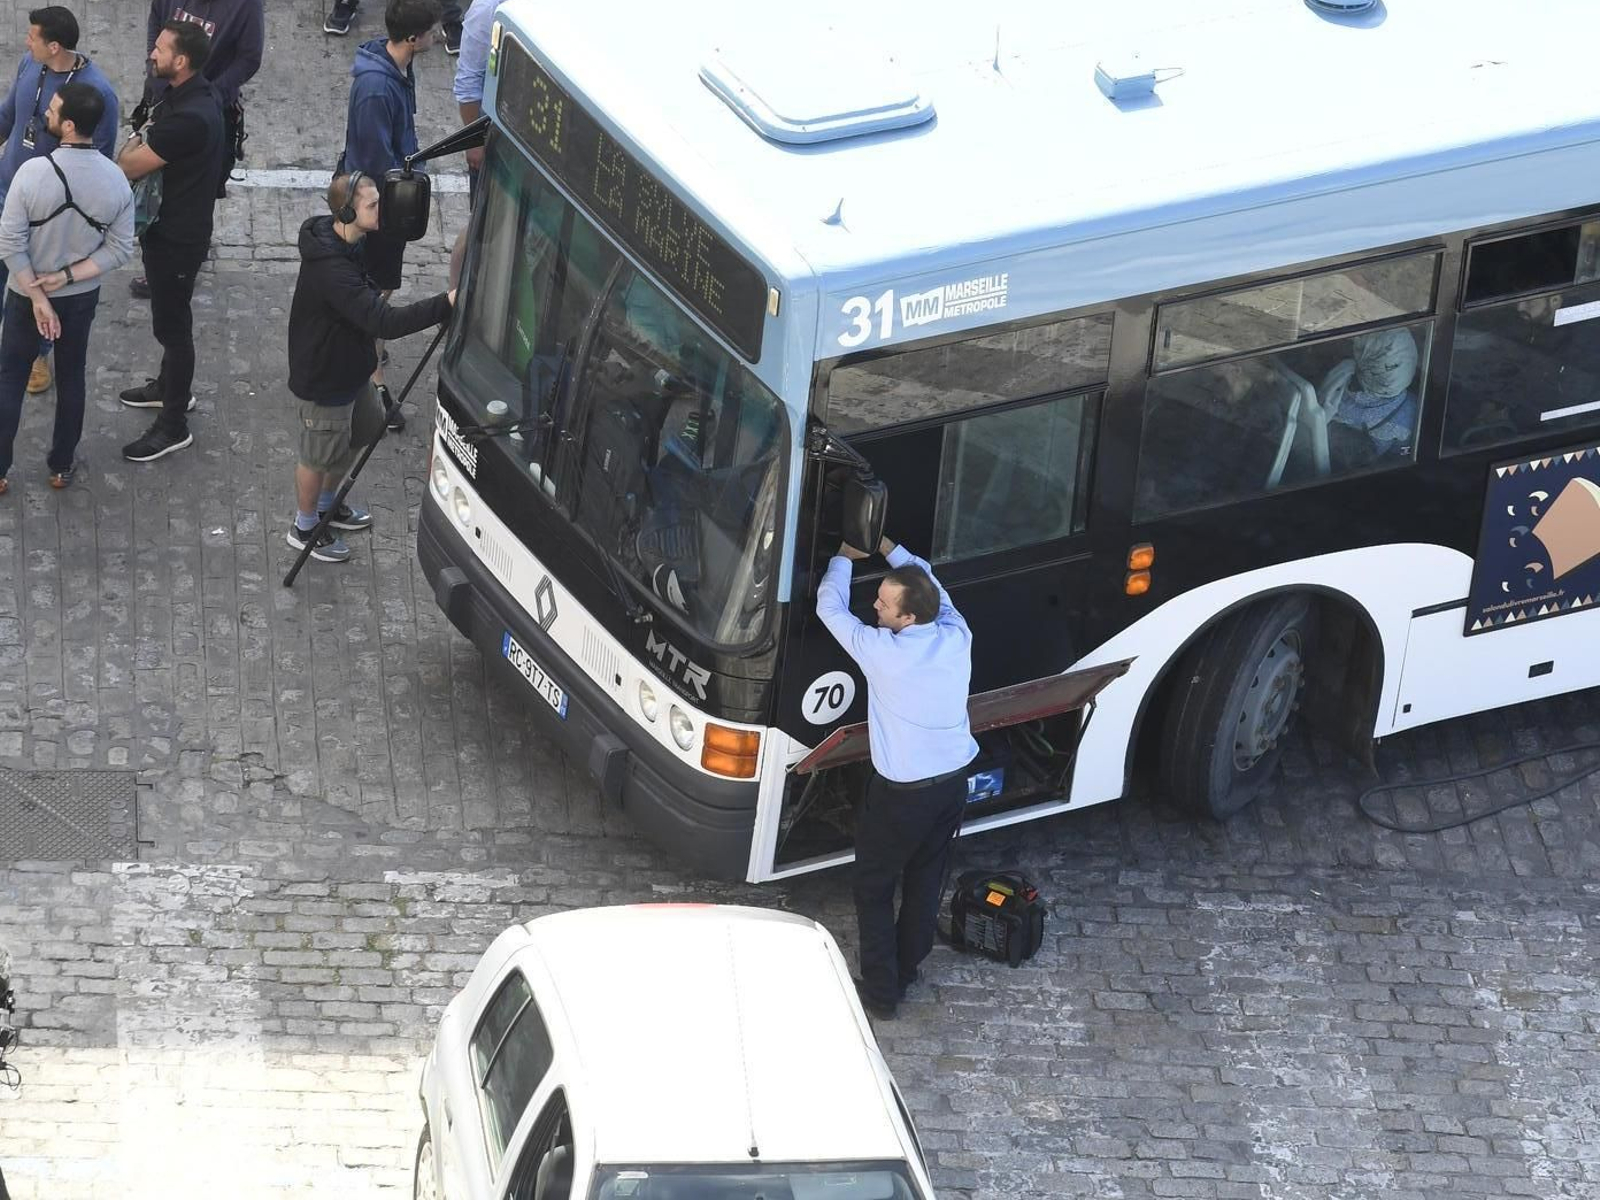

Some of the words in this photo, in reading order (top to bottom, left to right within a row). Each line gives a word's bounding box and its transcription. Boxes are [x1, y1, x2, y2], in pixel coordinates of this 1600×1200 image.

[529, 76, 564, 155] 31
[596, 132, 627, 187] LA
[593, 166, 624, 219] LA
[943, 296, 1007, 319] METROPOLE
[945, 272, 1009, 301] MARSEILLE
[837, 289, 894, 347] 31
[645, 629, 712, 701] MTR
[812, 683, 845, 714] 70
